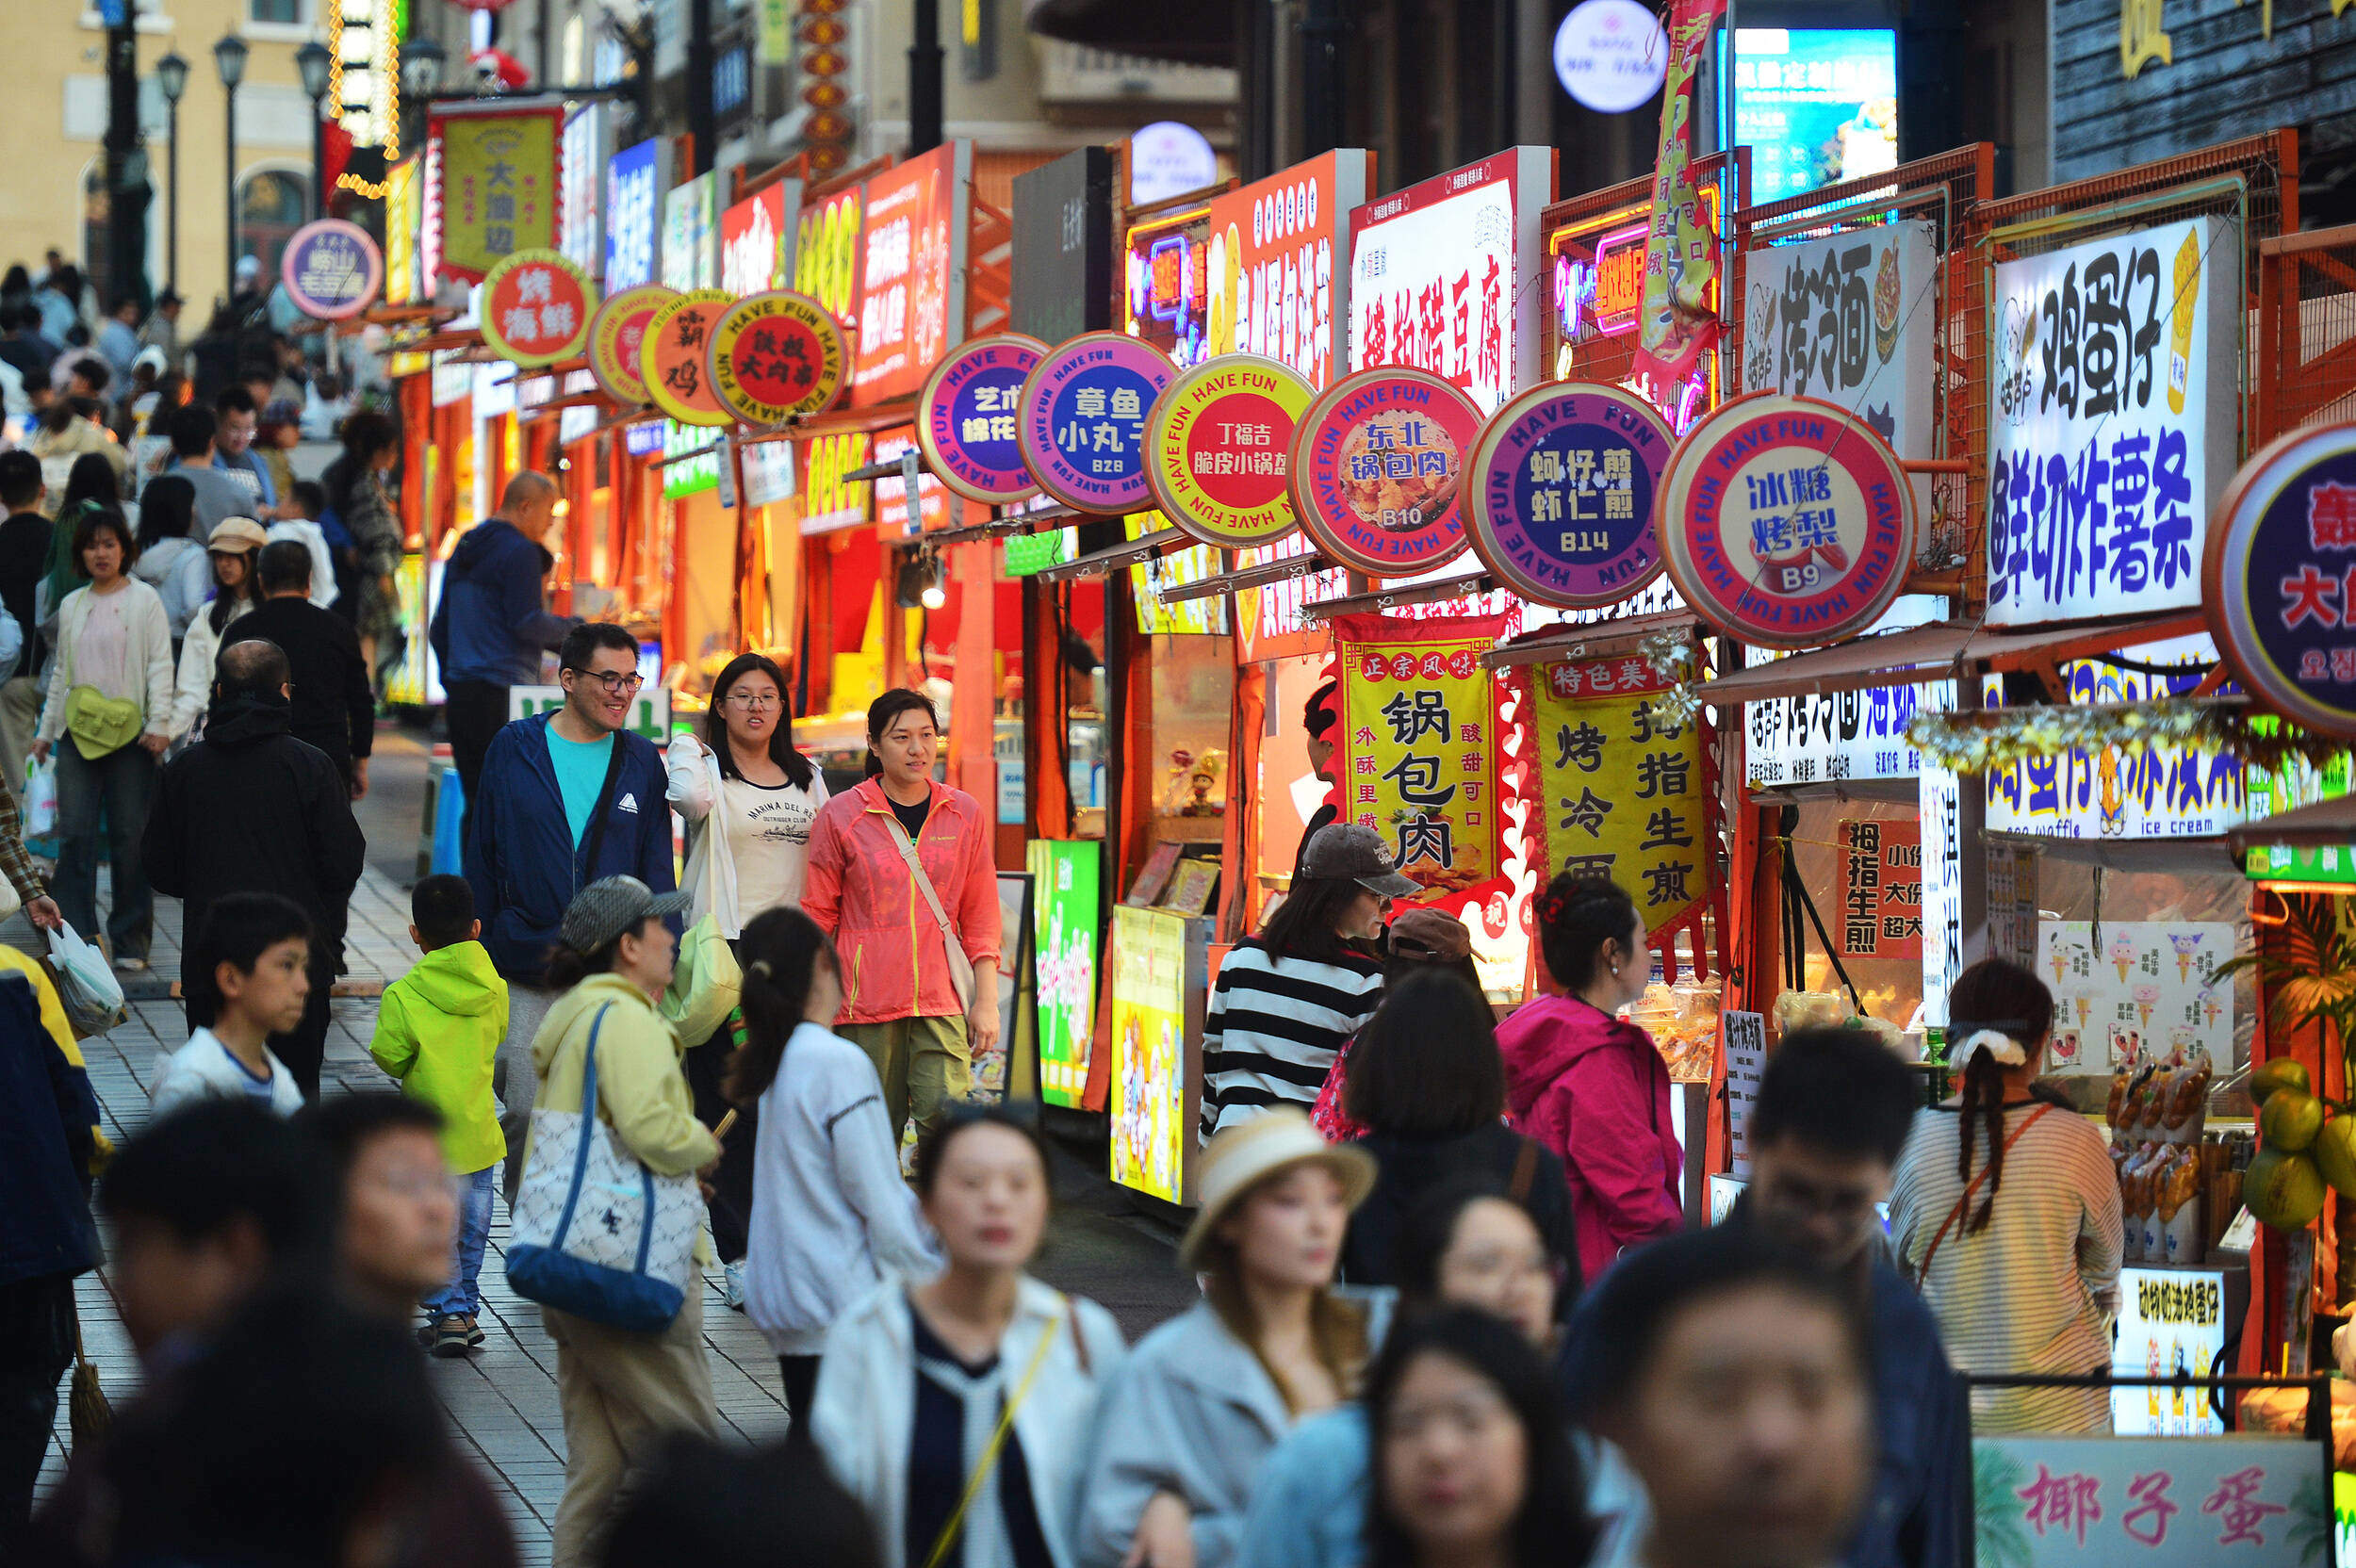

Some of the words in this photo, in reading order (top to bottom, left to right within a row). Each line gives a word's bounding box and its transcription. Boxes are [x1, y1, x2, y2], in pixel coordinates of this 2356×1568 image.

[728, 300, 774, 333] HAVE
[784, 301, 819, 327] FUN
[1779, 243, 1872, 396] 烤冷面
[2040, 246, 2161, 420] 鸡蛋仔
[718, 353, 734, 390] FUN
[946, 351, 997, 387] HAVE
[1054, 355, 1087, 382] HAVE
[1088, 350, 1114, 363] FUN
[1038, 388, 1054, 414] FUN
[1075, 386, 1142, 419] 章鱼
[1191, 373, 1237, 402] HAVE
[1242, 373, 1278, 393] FUN
[1340, 387, 1387, 422] HAVE
[1392, 384, 1431, 405] FUN
[736, 394, 785, 419] HAVE
[934, 403, 951, 445] FUN
[1169, 405, 1192, 441] FUN
[1510, 400, 1579, 448] HAVE
[1603, 405, 1655, 448] FUN
[1036, 416, 1053, 452] HAVE
[1217, 423, 1272, 446] 丁福吉
[1317, 427, 1341, 465] FUN
[1366, 420, 1429, 449] 东北
[1717, 423, 1775, 470] HAVE
[1777, 419, 1825, 441] FUN
[945, 449, 996, 488] HAVE
[1052, 459, 1074, 482] FUN
[1167, 446, 1191, 493] HAVE
[1350, 450, 1448, 481] 锅包肉
[1530, 449, 1632, 482] 蚵仔煎
[1075, 478, 1111, 495] HAVE
[1317, 471, 1347, 521] HAVE
[1492, 471, 1513, 527] FUN
[1693, 476, 1722, 523] FUN
[1746, 464, 1832, 511] 冰糖
[1189, 496, 1224, 524] FUN
[1227, 510, 1275, 529] HAVE
[1382, 508, 1423, 527] B10
[1531, 489, 1633, 522] 虾仁煎
[1869, 482, 1895, 545] HAVE
[1988, 425, 2192, 608] 鲜切炸薯条
[1347, 523, 1384, 552] FUN
[1389, 531, 1441, 555] HAVE
[1561, 531, 1609, 552] B14
[1751, 507, 1839, 554] 烤梨
[1505, 532, 1571, 586] HAVE
[1598, 547, 1649, 586] FUN
[1695, 530, 1733, 590] HAVE
[1781, 564, 1821, 590] B9
[1853, 552, 1890, 595] FUN
[1736, 590, 1784, 623] FUN
[1790, 595, 1851, 625] HAVE
[1363, 655, 1476, 678] 正宗风味
[1355, 726, 1380, 832] 外酥里嫩
[1381, 690, 1456, 871] 锅包肉
[1461, 723, 1484, 827] 酸甜可口
[747, 801, 782, 821] MARINA
[784, 801, 800, 813] DEL
[802, 807, 816, 821] RE
[2141, 817, 2161, 836] ice
[2170, 818, 2213, 835] cream
[1844, 822, 1881, 954] 拇指生煎
[2017, 1463, 2288, 1546] 椰子蛋
